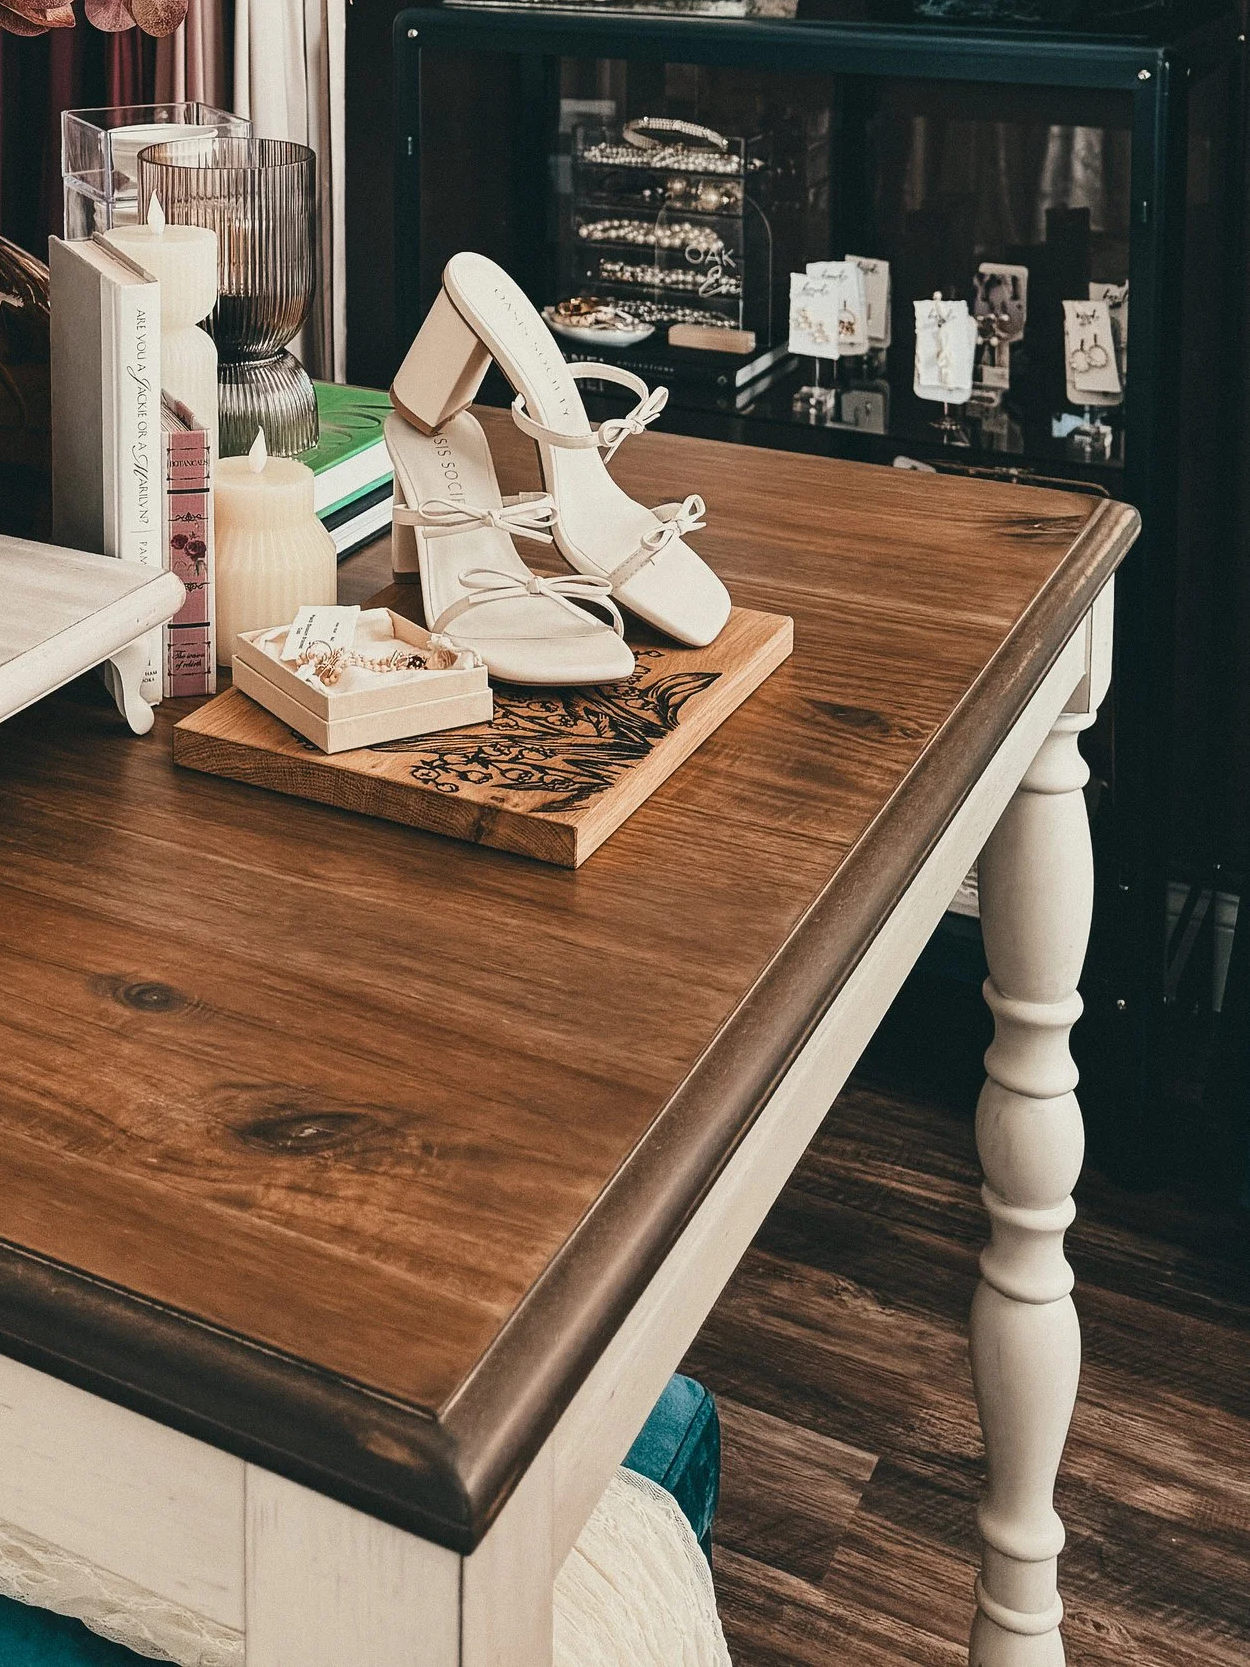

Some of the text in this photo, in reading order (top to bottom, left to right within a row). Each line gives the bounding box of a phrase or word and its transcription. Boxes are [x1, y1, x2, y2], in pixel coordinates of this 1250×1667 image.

[685, 244, 736, 268] OAK
[126, 309, 152, 524] ARE YOU A JACKIE OR A MARILYN?
[432, 431, 452, 457] ASIS
